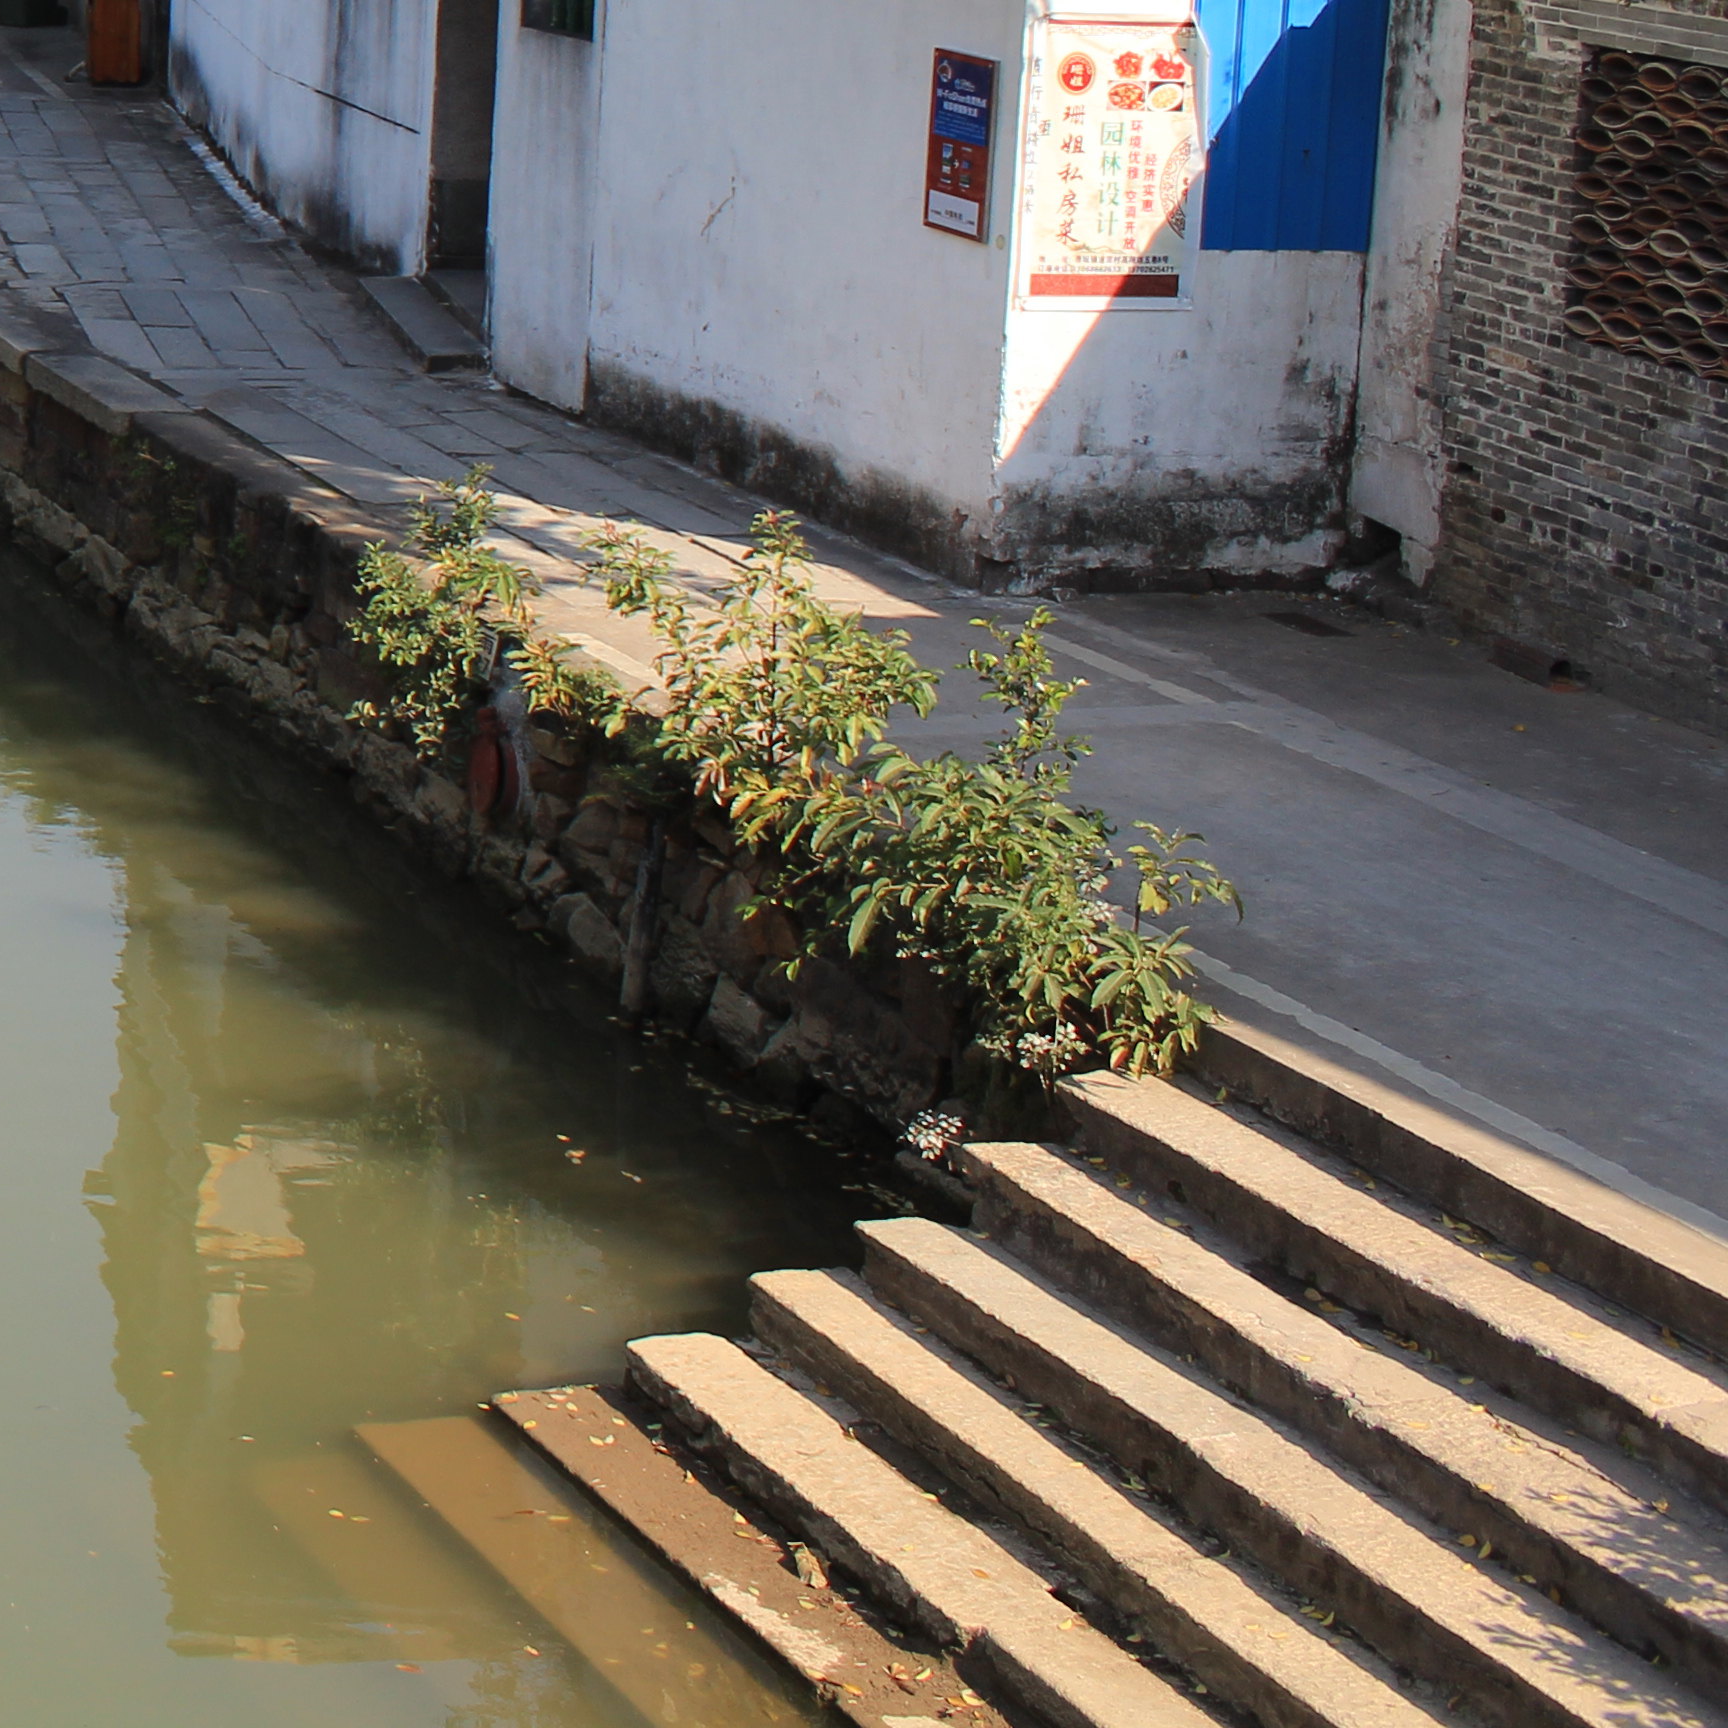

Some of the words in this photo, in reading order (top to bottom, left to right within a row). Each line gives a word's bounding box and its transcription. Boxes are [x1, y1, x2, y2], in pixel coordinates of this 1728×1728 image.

[1056, 105, 1086, 246] 珊姐私房菜
[1097, 121, 1124, 237] 园林设计
[1126, 119, 1144, 180] 环境优雅
[1141, 153, 1158, 213] 经济实惠
[1122, 190, 1139, 250] 空调开放
